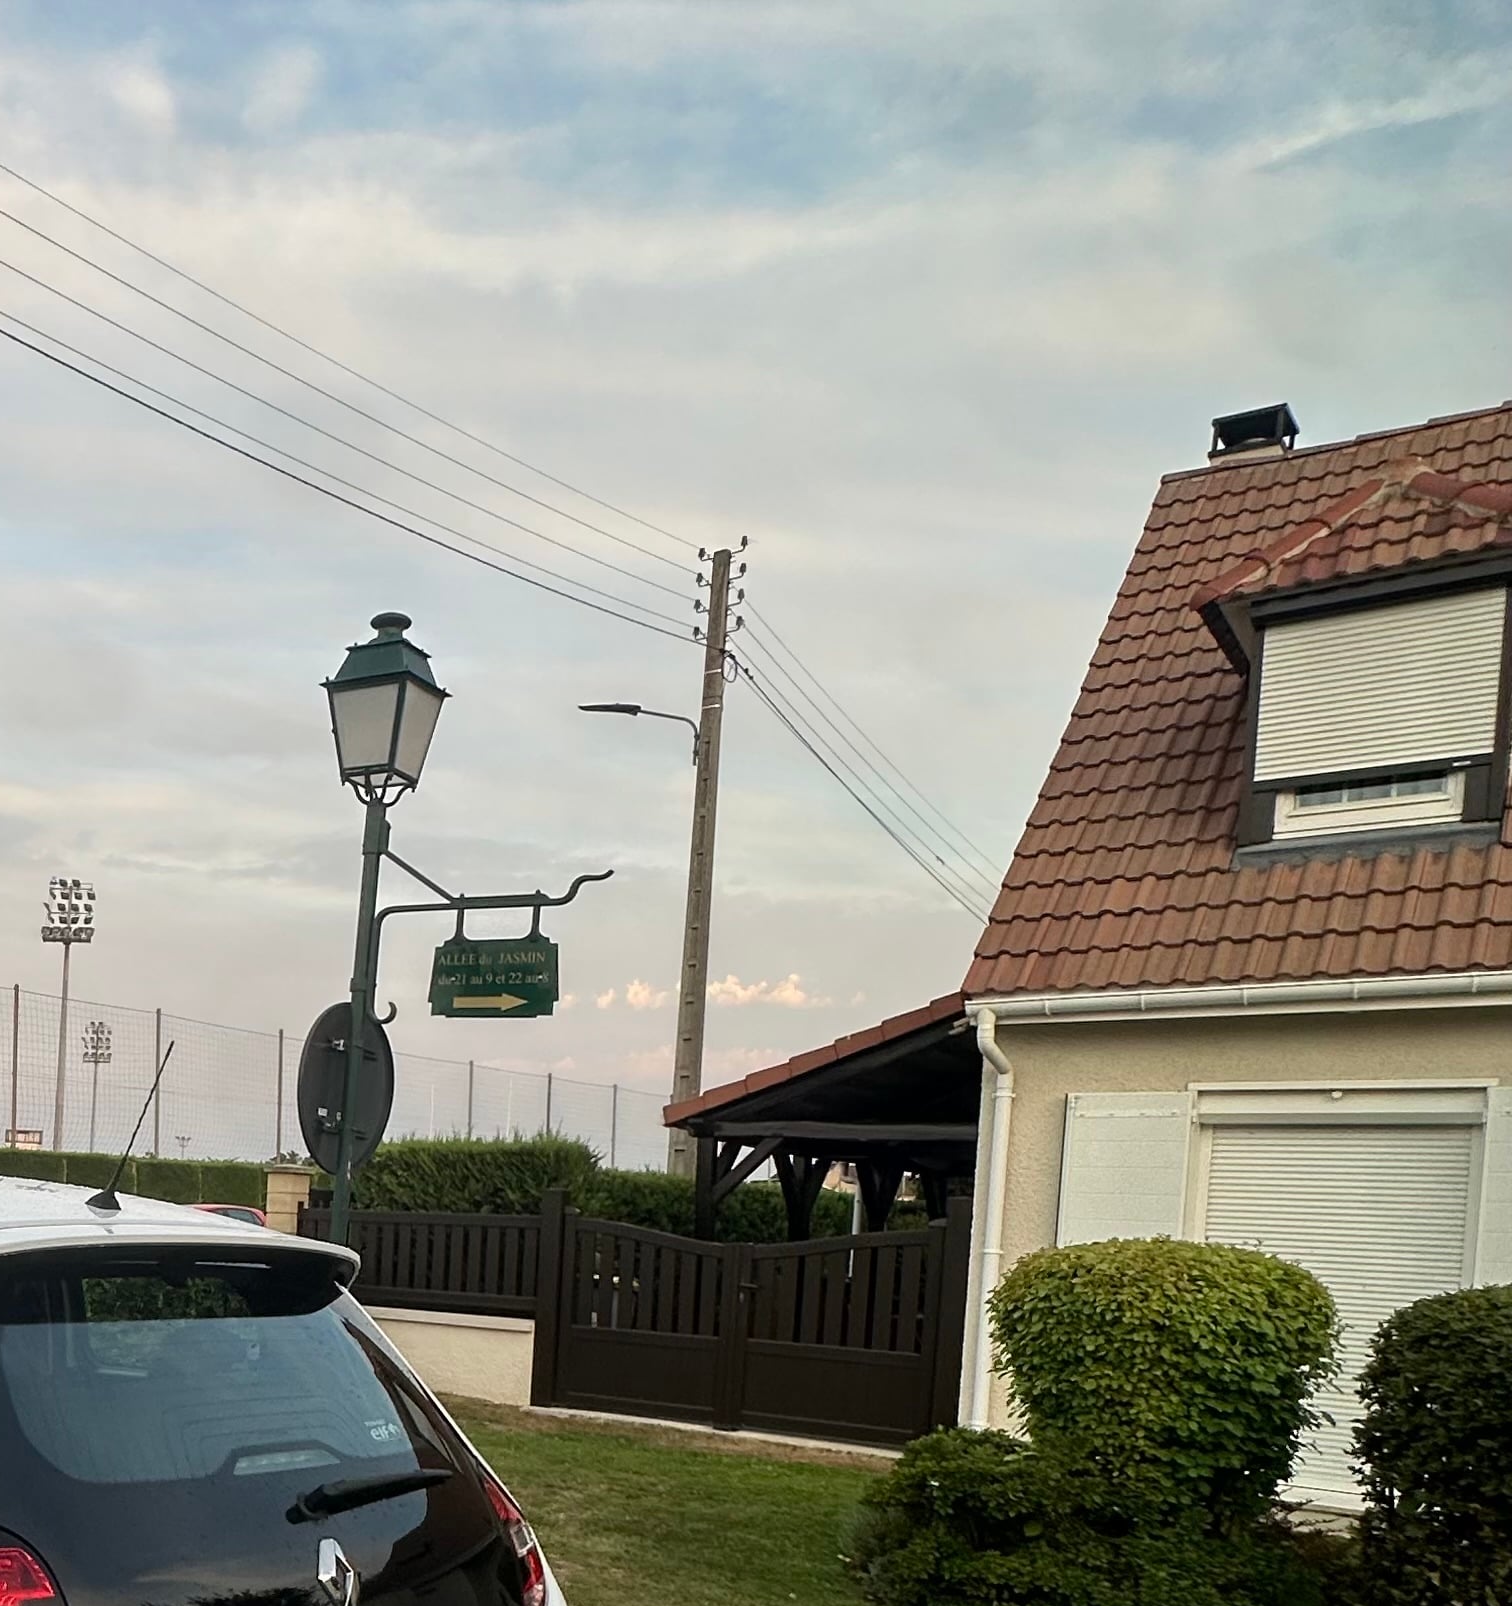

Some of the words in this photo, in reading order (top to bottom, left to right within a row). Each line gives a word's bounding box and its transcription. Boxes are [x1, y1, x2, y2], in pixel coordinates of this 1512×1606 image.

[497, 952, 545, 965] JASMIN
[485, 972, 493, 984] 9
[508, 972, 522, 984] 22
[370, 1425, 389, 1440] elf
